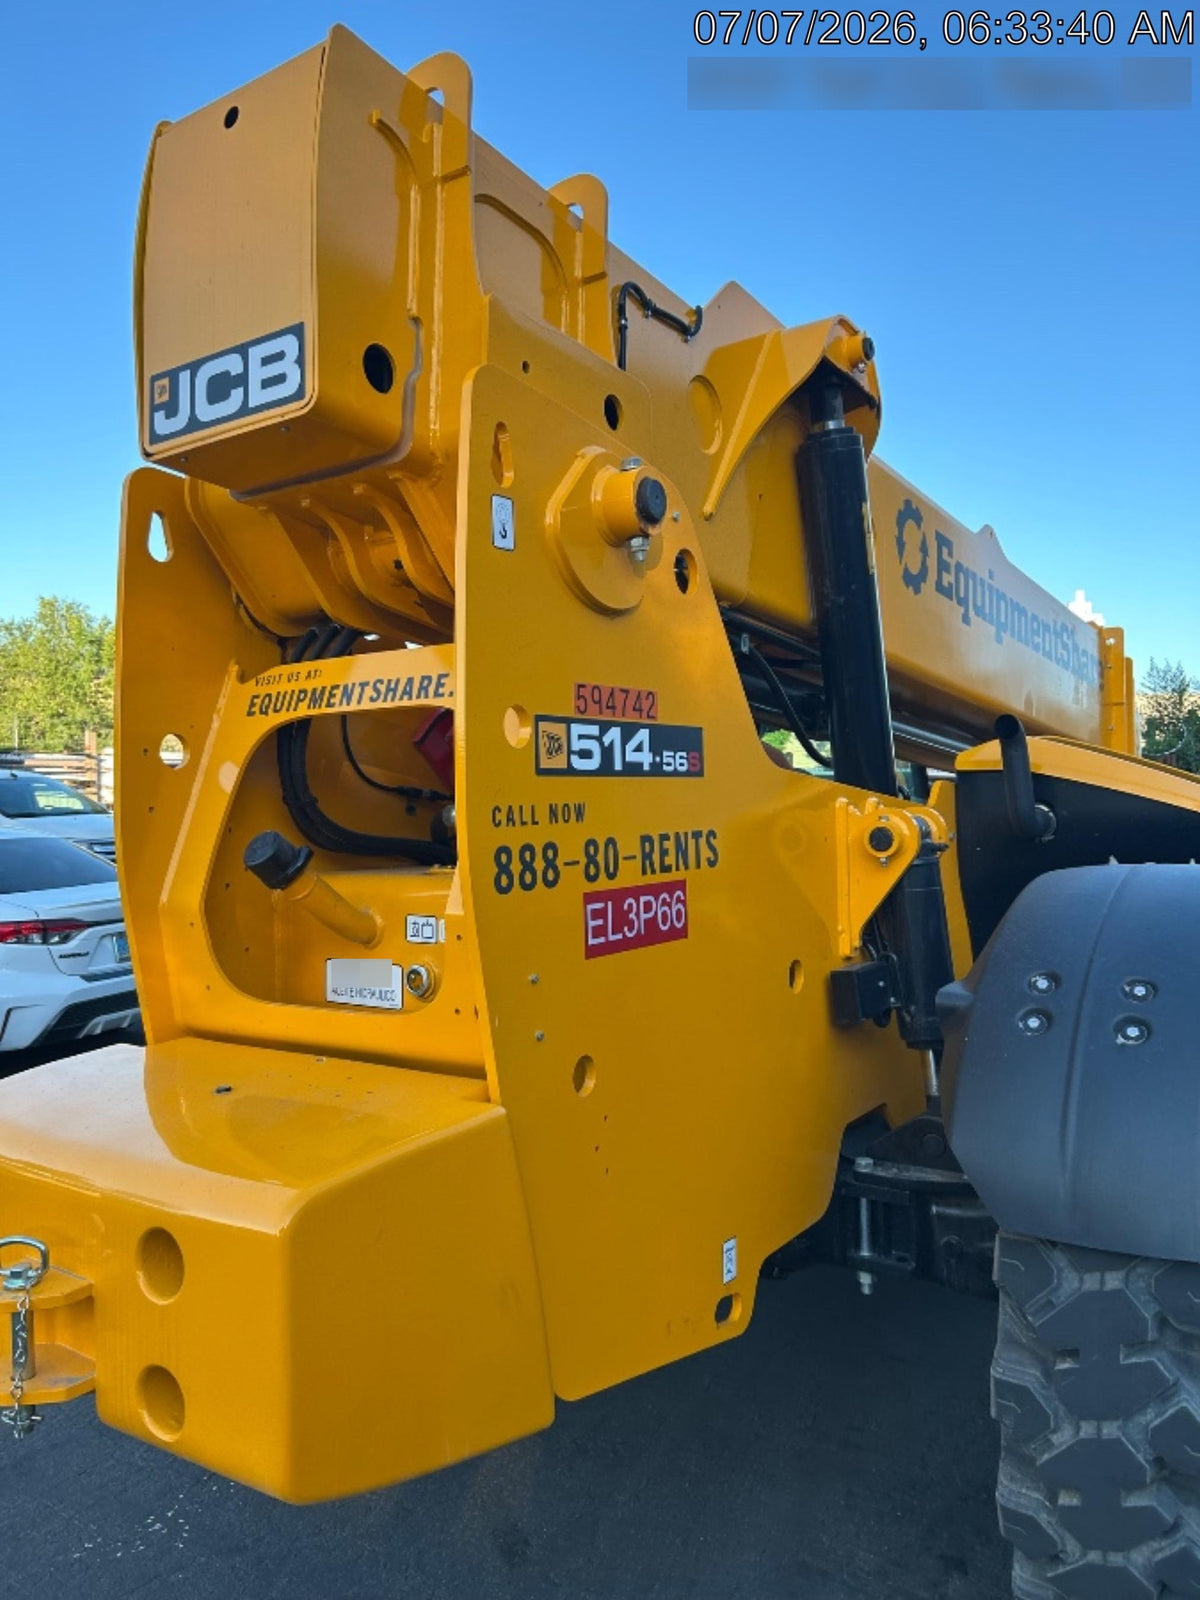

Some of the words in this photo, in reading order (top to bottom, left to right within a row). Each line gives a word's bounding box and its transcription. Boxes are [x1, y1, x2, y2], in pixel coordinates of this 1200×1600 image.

[153, 333, 301, 435] JCB
[254, 673, 283, 687] VISIT
[286, 671, 301, 684] US
[576, 684, 656, 720] 594742
[491, 804, 540, 828] CALL
[548, 802, 586, 825] NOW
[493, 828, 719, 895] 888-80-RENTS
[586, 890, 686, 946] EL3P66
